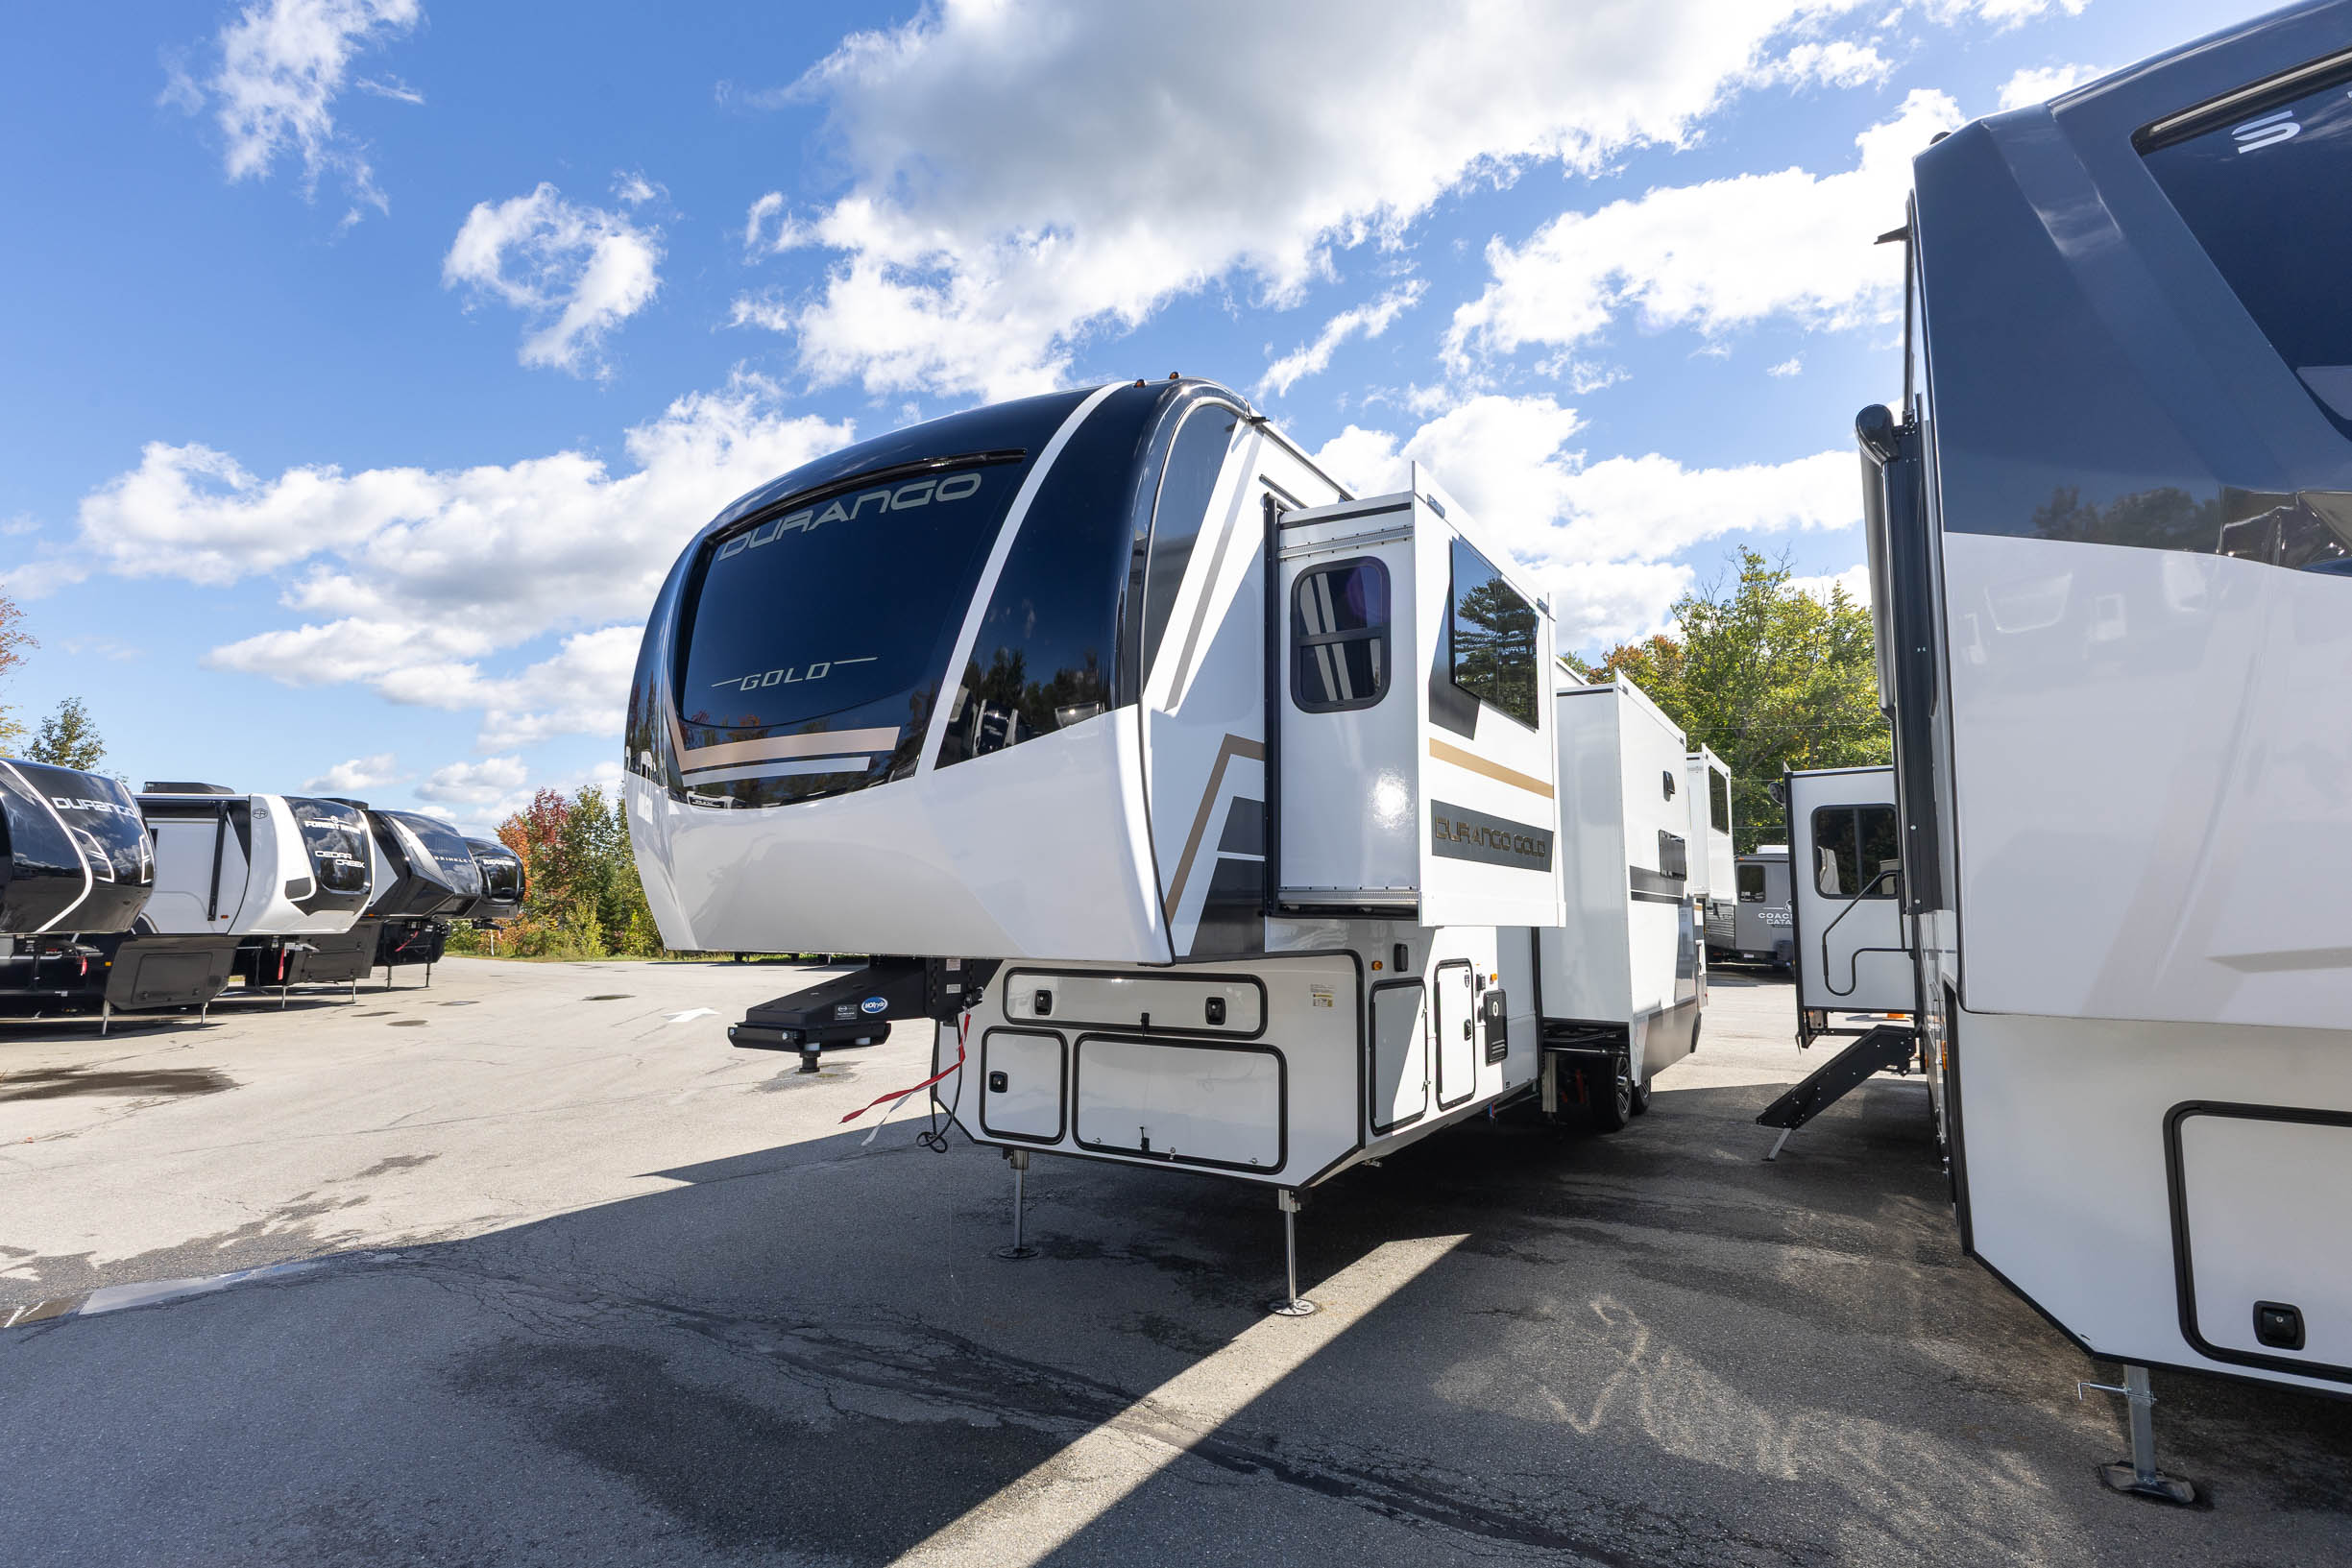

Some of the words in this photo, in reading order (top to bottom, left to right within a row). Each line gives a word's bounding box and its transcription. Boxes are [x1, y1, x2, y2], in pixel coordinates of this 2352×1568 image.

[718, 472, 982, 562] DURANGO
[740, 662, 831, 691] GOLD
[51, 797, 137, 819] DURANGO
[1435, 815, 1512, 852] DURANGO
[1514, 833, 1546, 857] GOLD
[315, 850, 352, 859] CEDAR
[335, 858, 365, 869] CREEK
